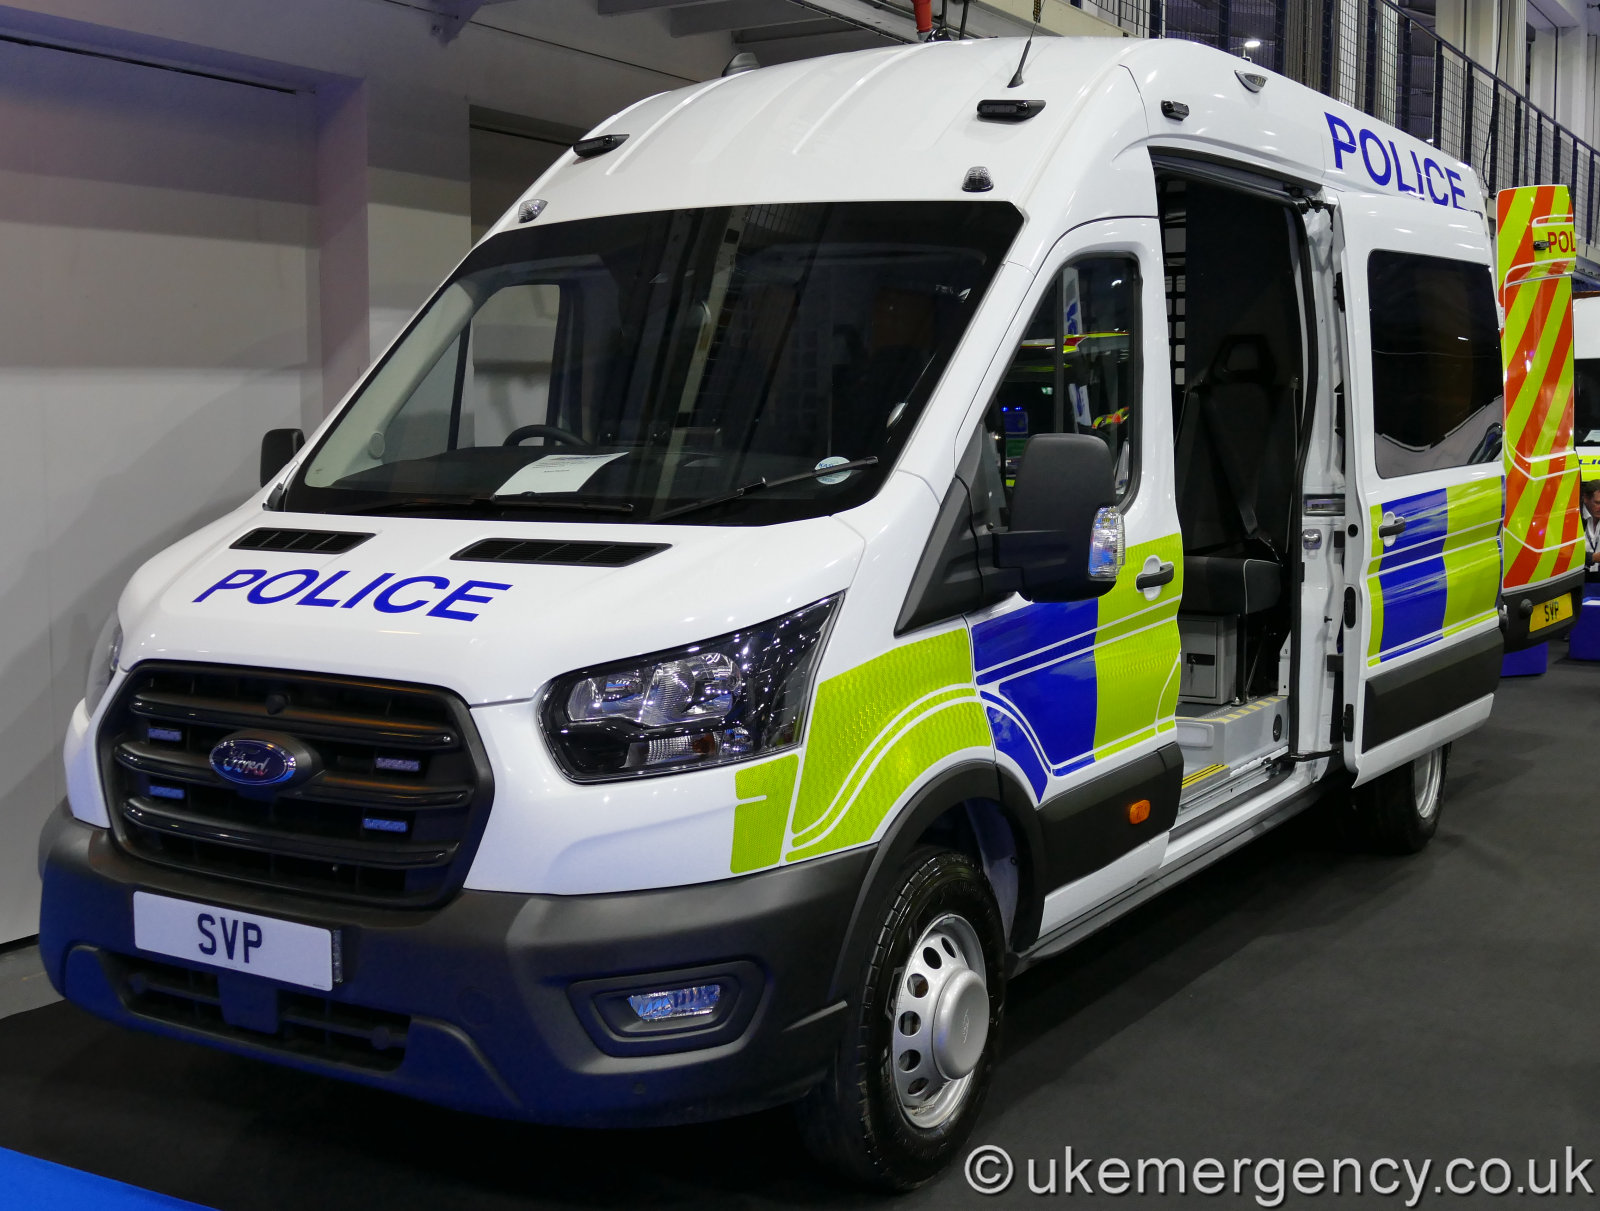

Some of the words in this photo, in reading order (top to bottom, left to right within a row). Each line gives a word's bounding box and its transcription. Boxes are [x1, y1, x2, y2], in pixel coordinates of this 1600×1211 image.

[1324, 111, 1467, 211] POLICE
[1547, 230, 1576, 253] POL
[192, 568, 513, 622] POLICE
[1544, 600, 1560, 623] SVP
[223, 751, 270, 777] Ford
[197, 912, 263, 964] SVP
